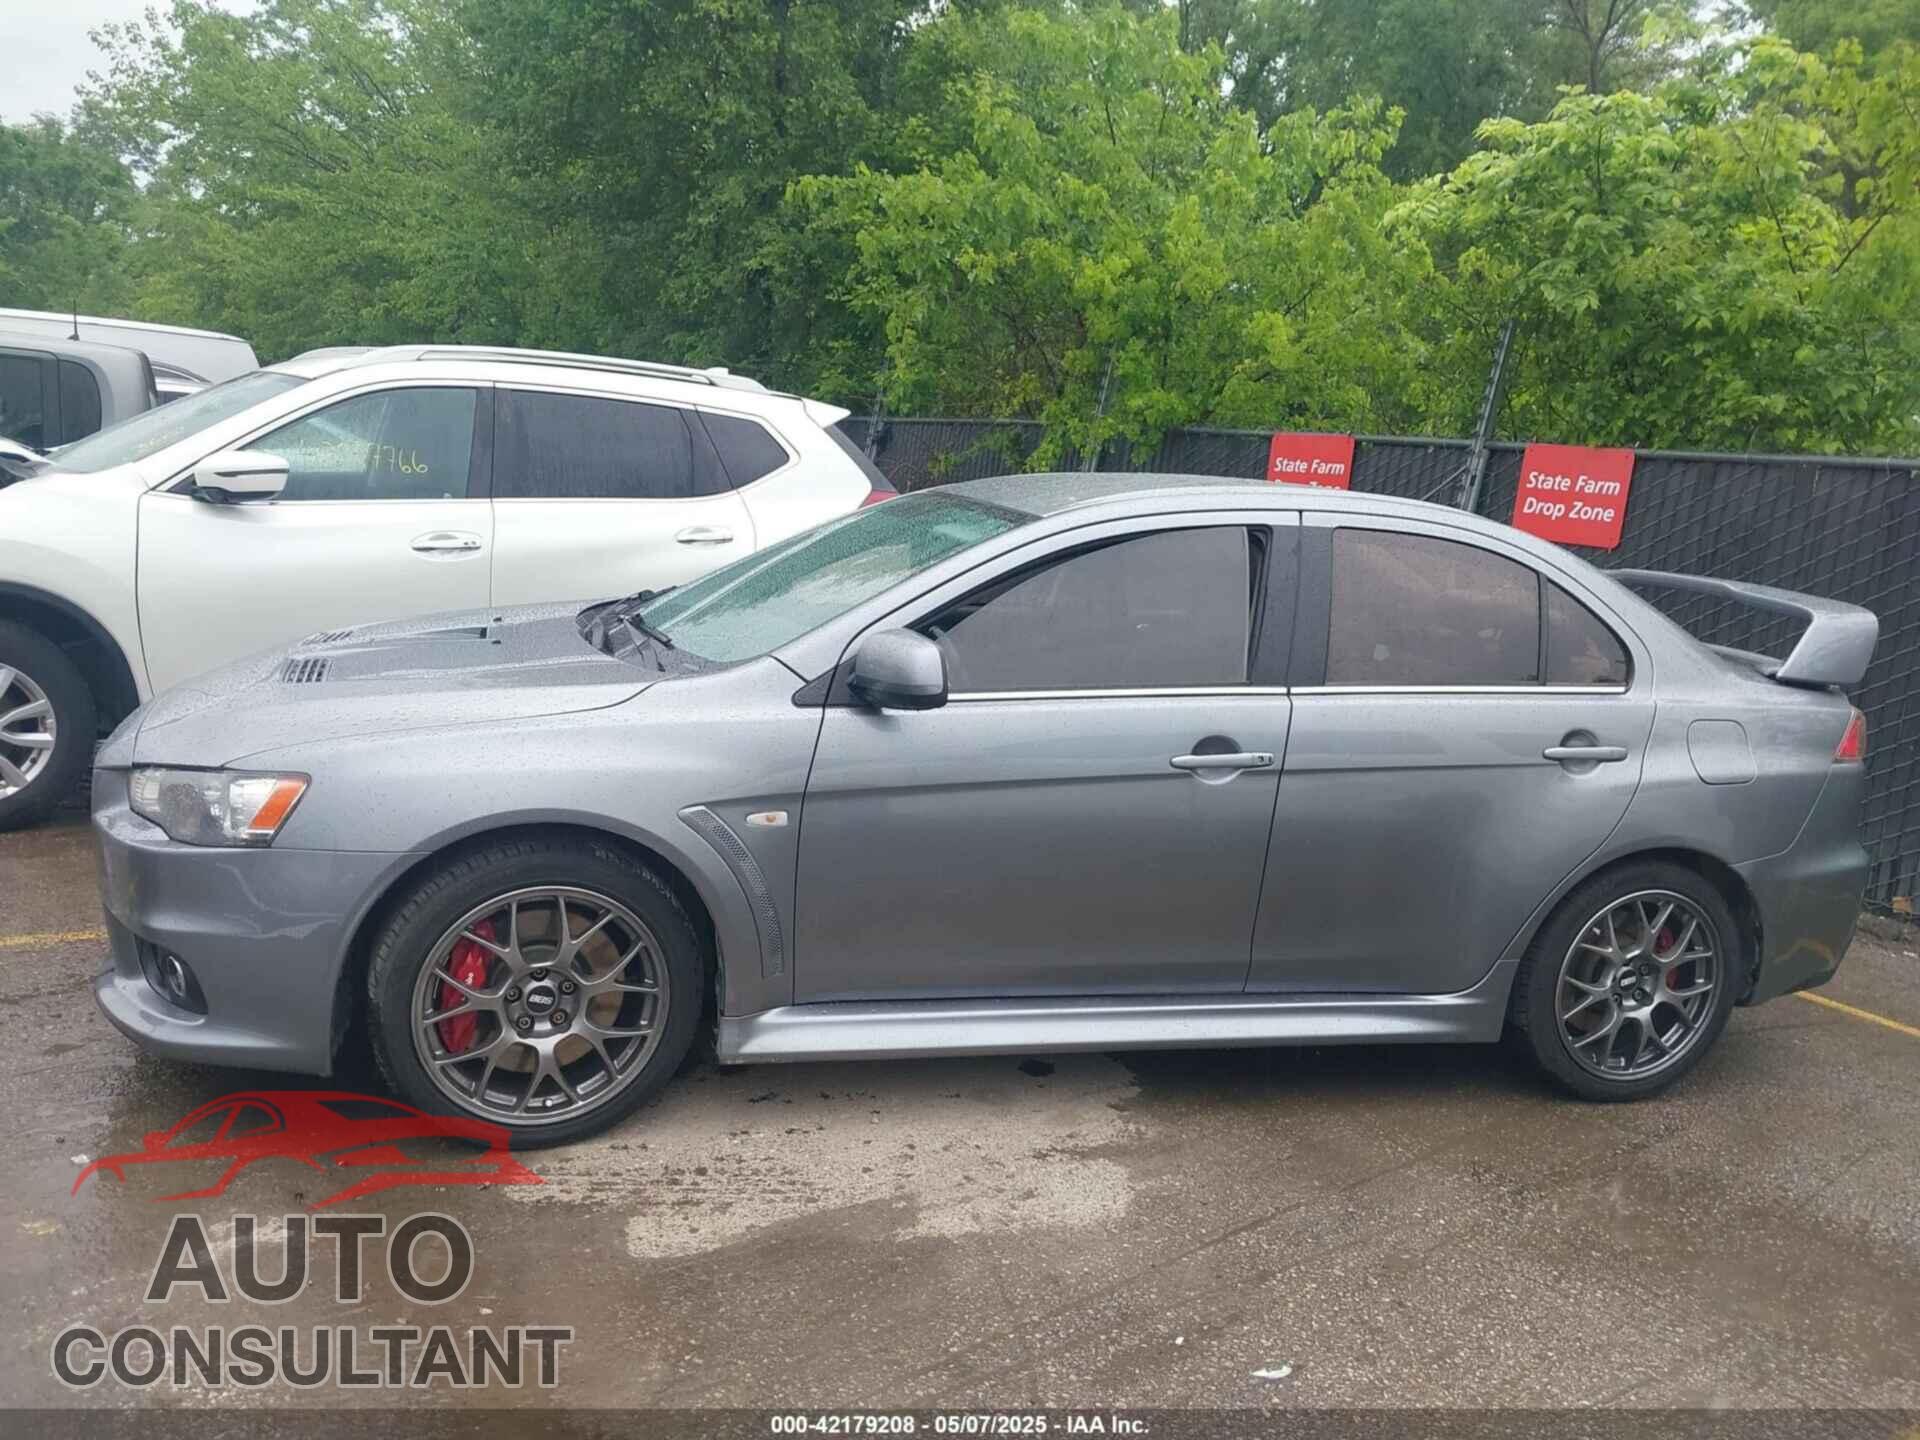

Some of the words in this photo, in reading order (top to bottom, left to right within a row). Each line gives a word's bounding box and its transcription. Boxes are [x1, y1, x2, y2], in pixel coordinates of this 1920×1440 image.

[1273, 457, 1308, 473] State
[1311, 459, 1345, 475] Farm
[1526, 471, 1571, 491] State
[1575, 475, 1620, 496] Farm
[1523, 497, 1566, 520] Drop
[1569, 501, 1615, 522] Zone
